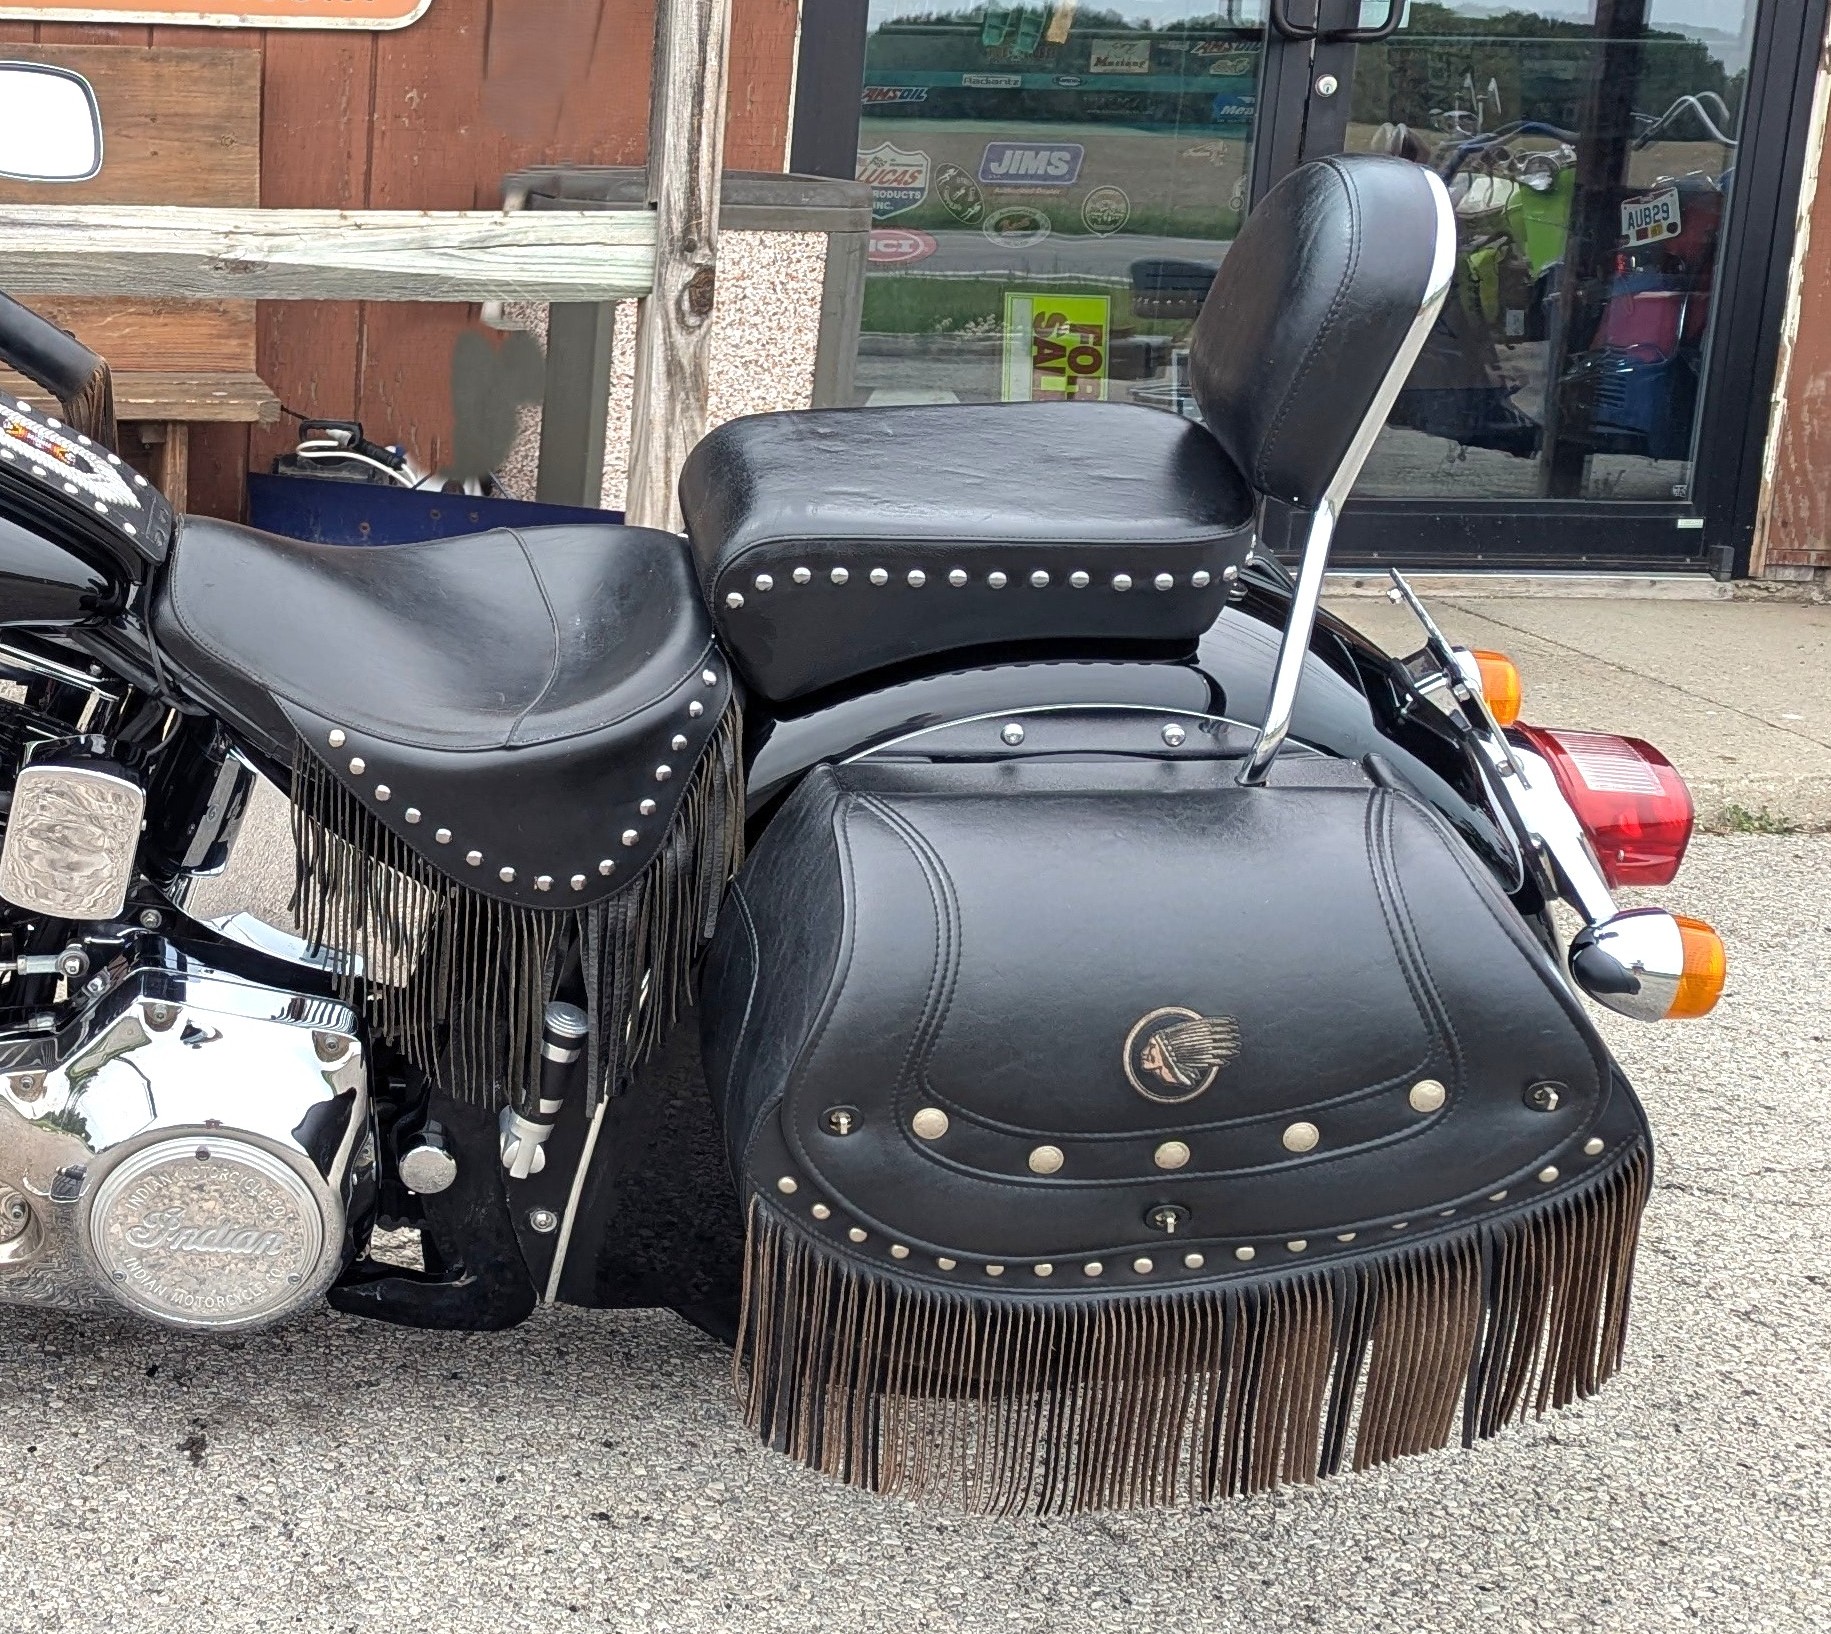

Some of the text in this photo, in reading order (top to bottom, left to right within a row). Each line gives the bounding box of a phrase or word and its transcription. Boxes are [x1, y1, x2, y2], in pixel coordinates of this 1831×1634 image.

[862, 87, 928, 102] AMSOIL
[990, 150, 1071, 176] JIMS
[856, 167, 923, 186] LUCAS
[872, 190, 922, 199] RODUCTS
[873, 202, 894, 210] INC.
[1628, 202, 1670, 231] AUB29
[125, 1206, 285, 1255] Indian
